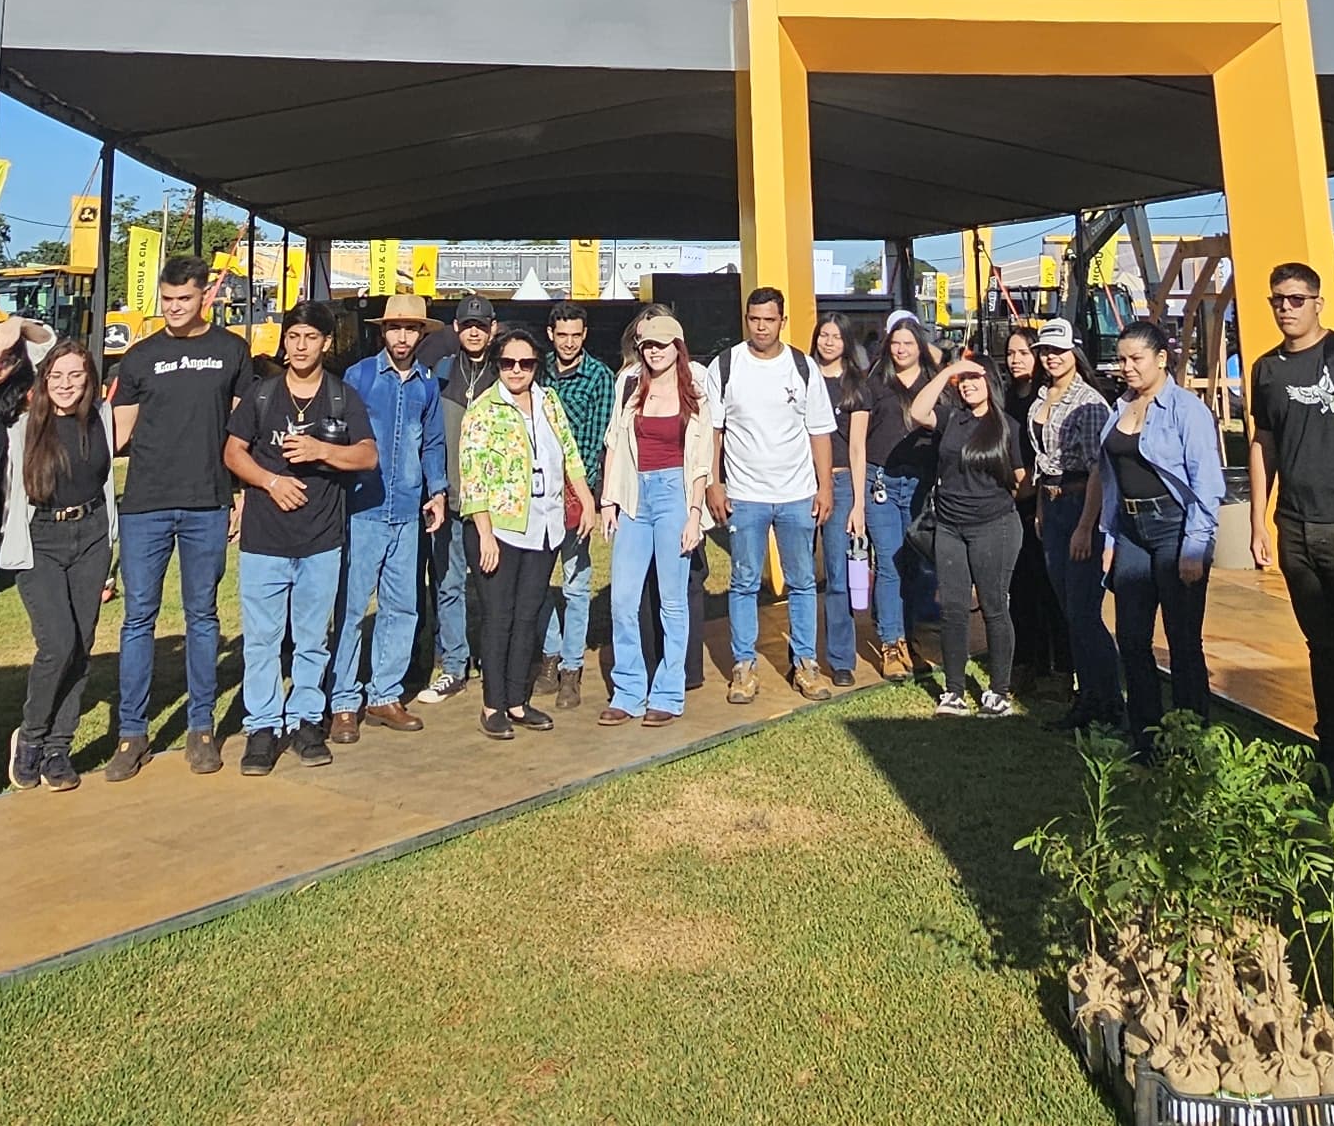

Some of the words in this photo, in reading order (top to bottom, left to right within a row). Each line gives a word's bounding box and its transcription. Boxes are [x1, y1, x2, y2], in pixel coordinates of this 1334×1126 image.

[618, 261, 674, 270] VOLV
[154, 360, 178, 375] Los
[178, 355, 224, 371] Angeles
